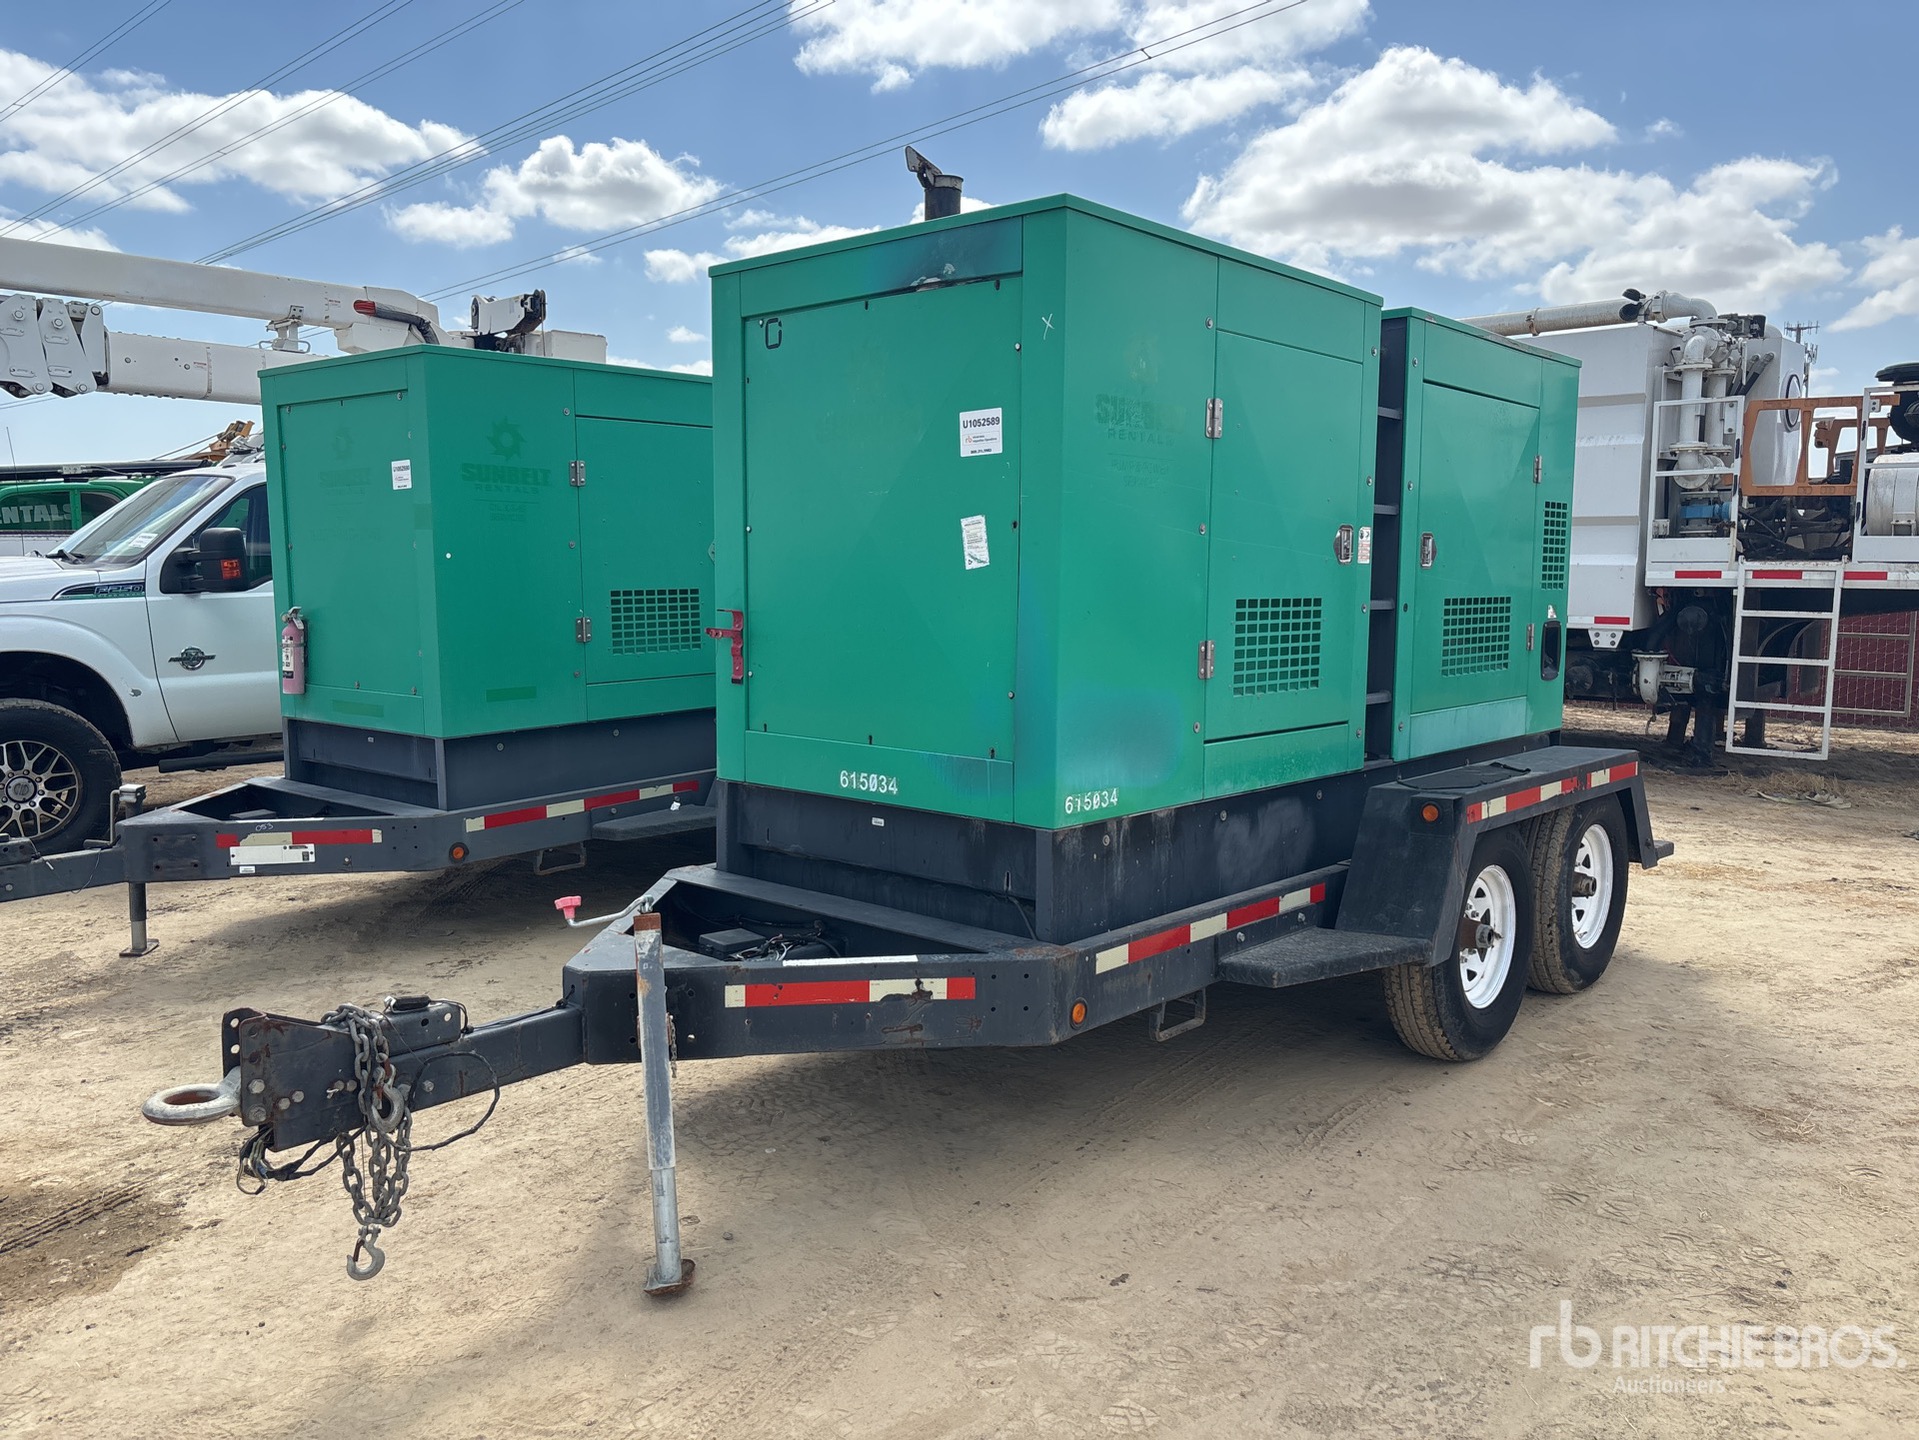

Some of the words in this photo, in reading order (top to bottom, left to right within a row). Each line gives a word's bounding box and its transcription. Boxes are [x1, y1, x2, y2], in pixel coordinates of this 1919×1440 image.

[962, 416, 1000, 429] U1052589
[461, 463, 552, 486] SUNBELT
[0, 504, 72, 524] NTALS
[839, 770, 898, 795] 615034
[1064, 788, 1118, 814] 615034
